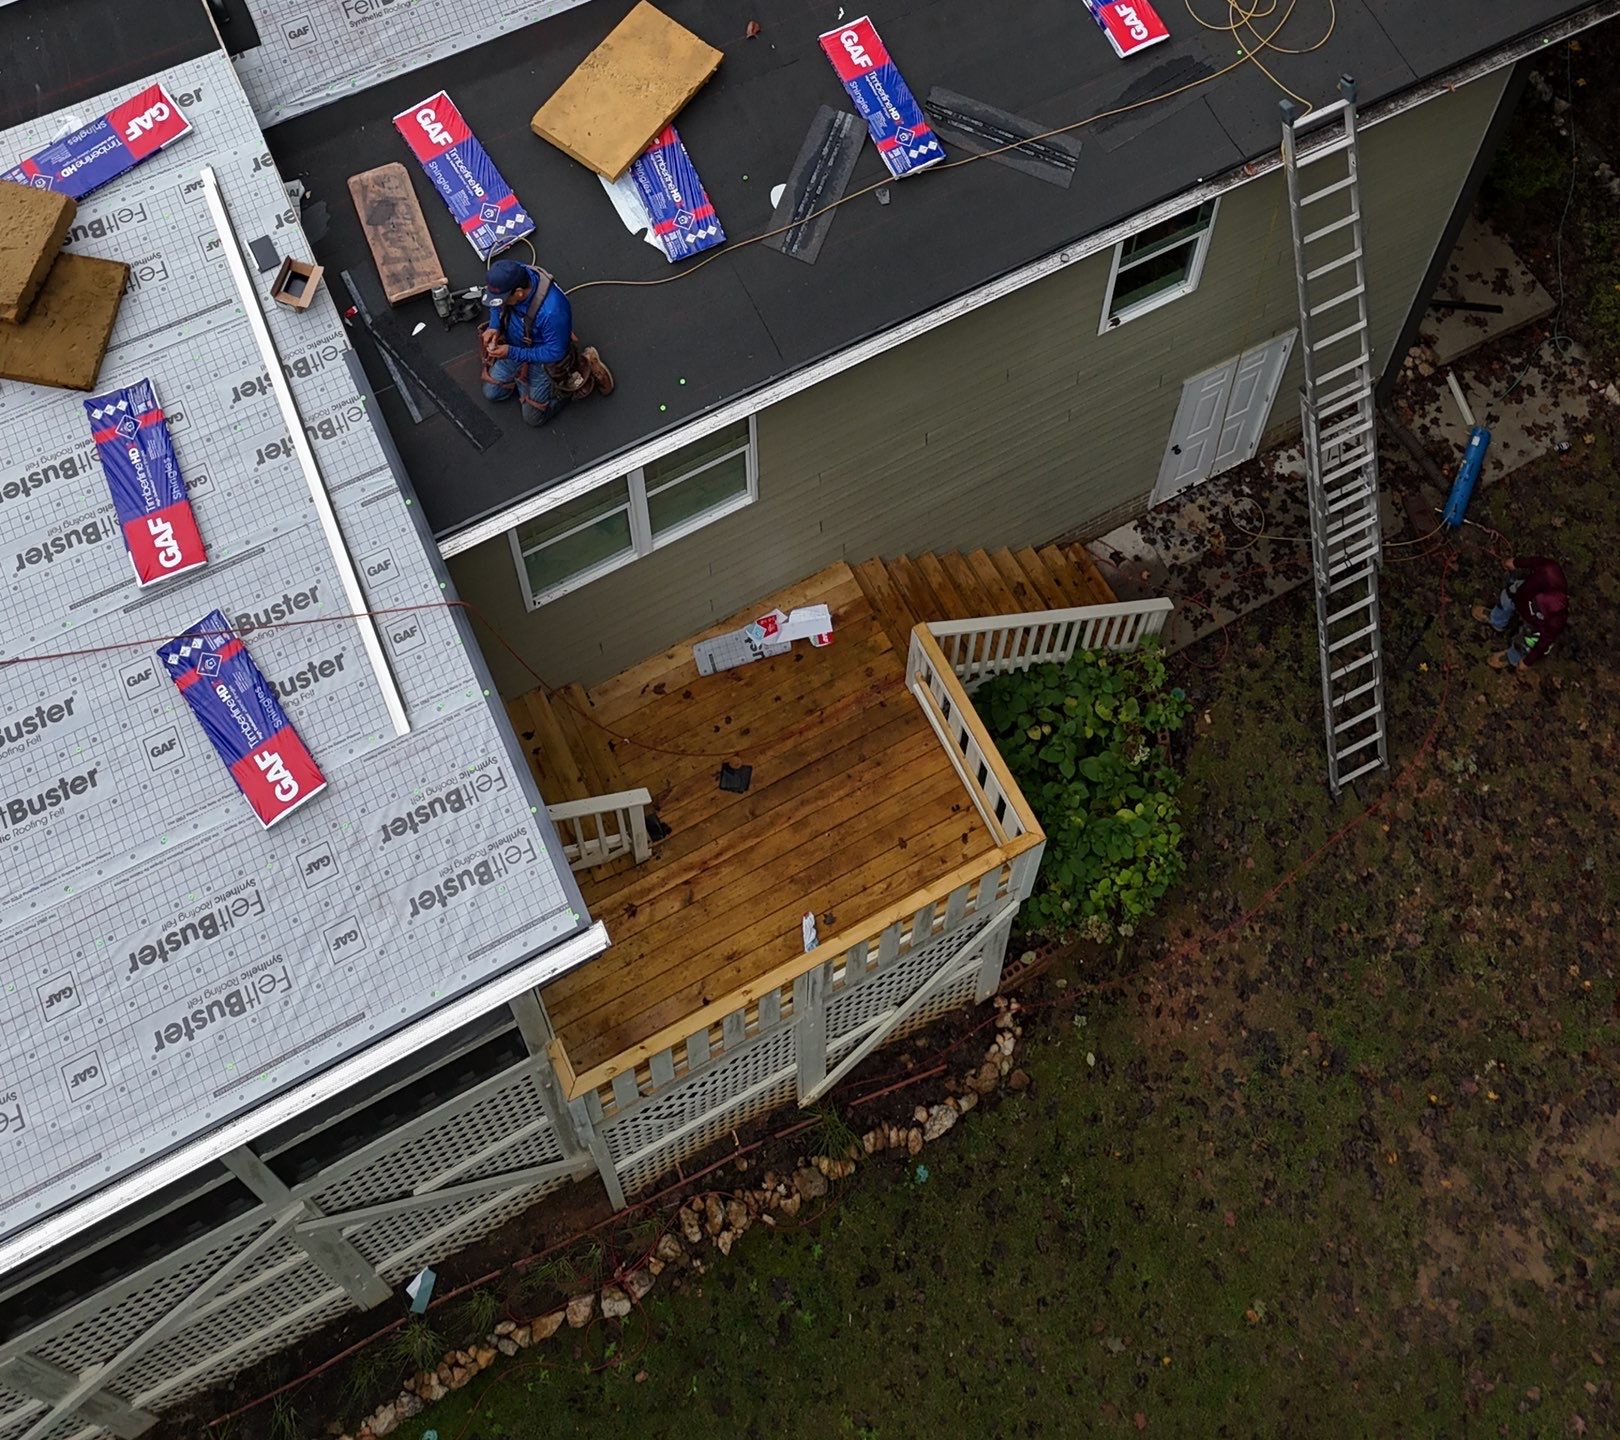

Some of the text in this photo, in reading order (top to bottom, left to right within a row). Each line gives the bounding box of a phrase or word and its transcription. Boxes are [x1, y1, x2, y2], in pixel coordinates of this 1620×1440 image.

[1115, 4, 1148, 40] GAF
[288, 26, 309, 40] GAF
[840, 30, 873, 68] GAF
[125, 102, 169, 142] GAF
[416, 109, 453, 146] GAF
[147, 517, 182, 568] GAF
[367, 559, 390, 576] GAF
[393, 626, 417, 644] GAF
[126, 671, 152, 687] GAF
[150, 739, 176, 757] GAF
[253, 750, 299, 802] GAF
[305, 856, 330, 875] GAF
[333, 931, 358, 949] GAF
[46, 987, 73, 1006] GAF
[71, 1066, 99, 1088] GAF
